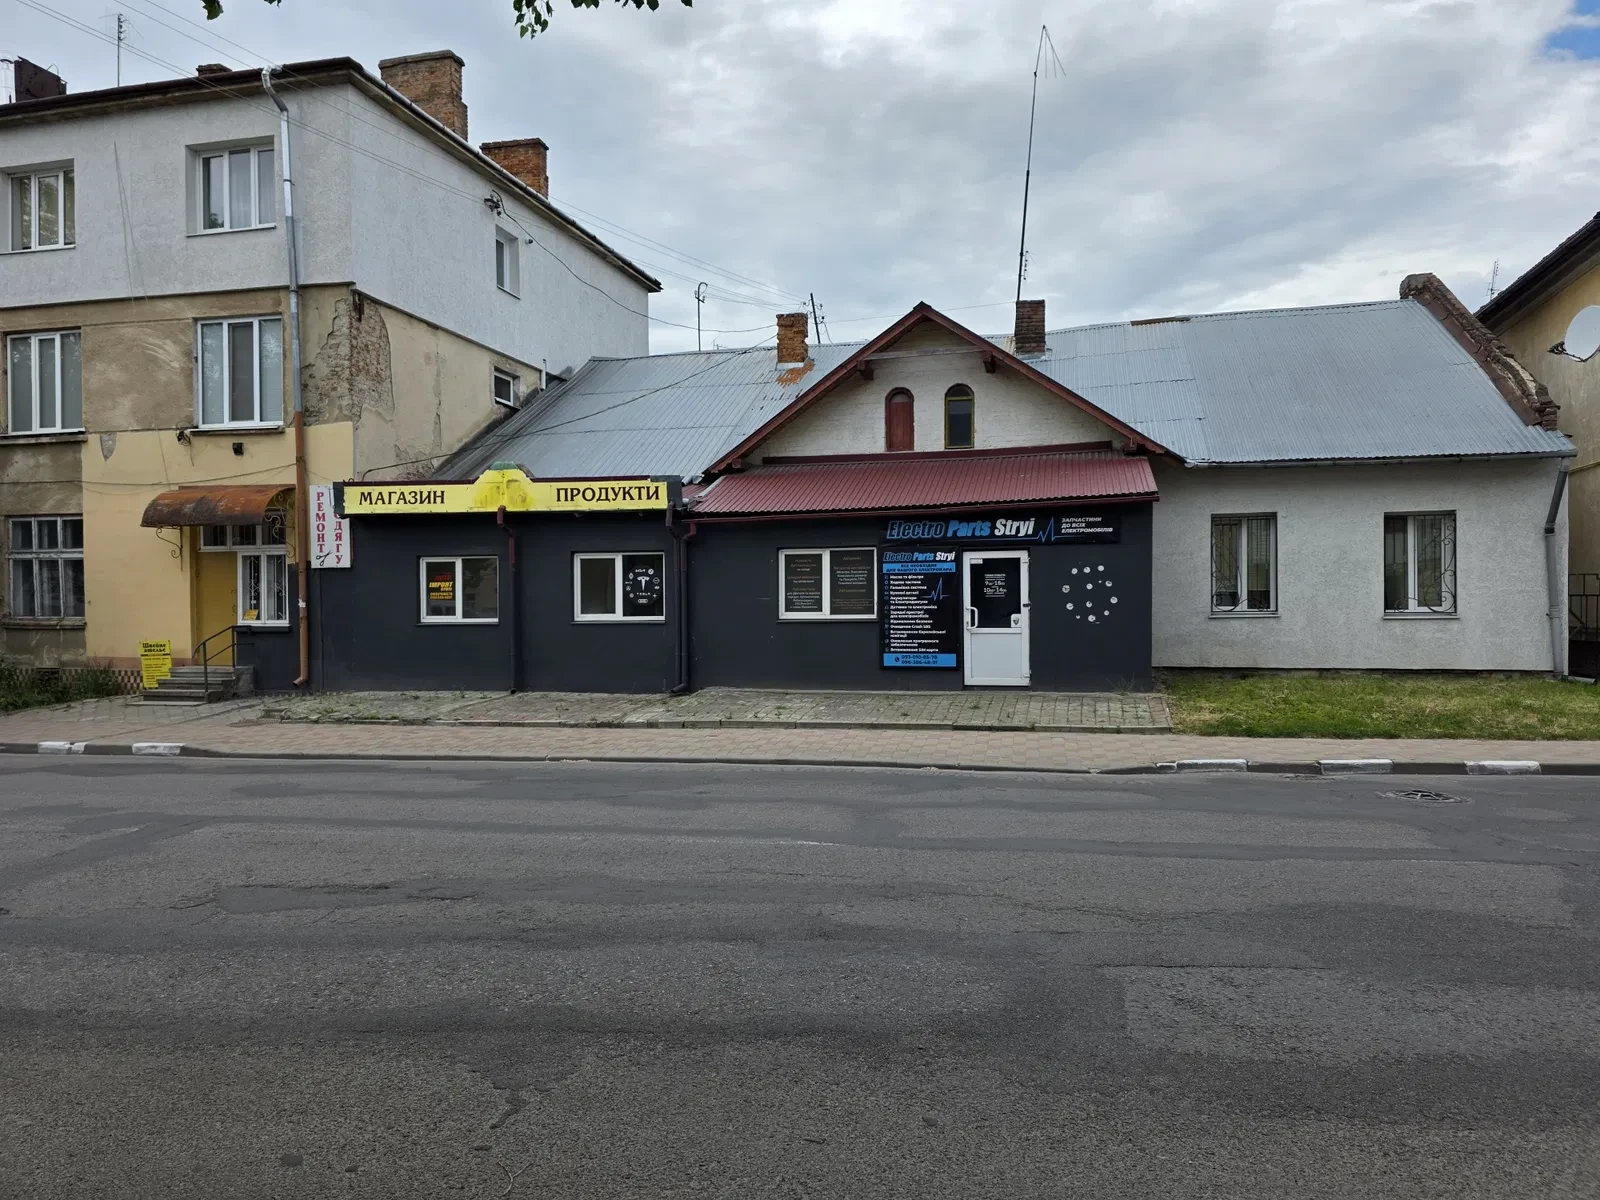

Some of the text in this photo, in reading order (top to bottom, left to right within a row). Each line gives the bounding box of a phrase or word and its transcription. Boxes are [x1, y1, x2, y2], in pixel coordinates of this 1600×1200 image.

[359, 486, 660, 505] МАГАЗИН ПРОДУКТИ
[316, 492, 326, 552] РЕМОНТ
[887, 518, 1036, 539] Electro Parts Stryi
[883, 552, 955, 561] Electro Parts Stryi
